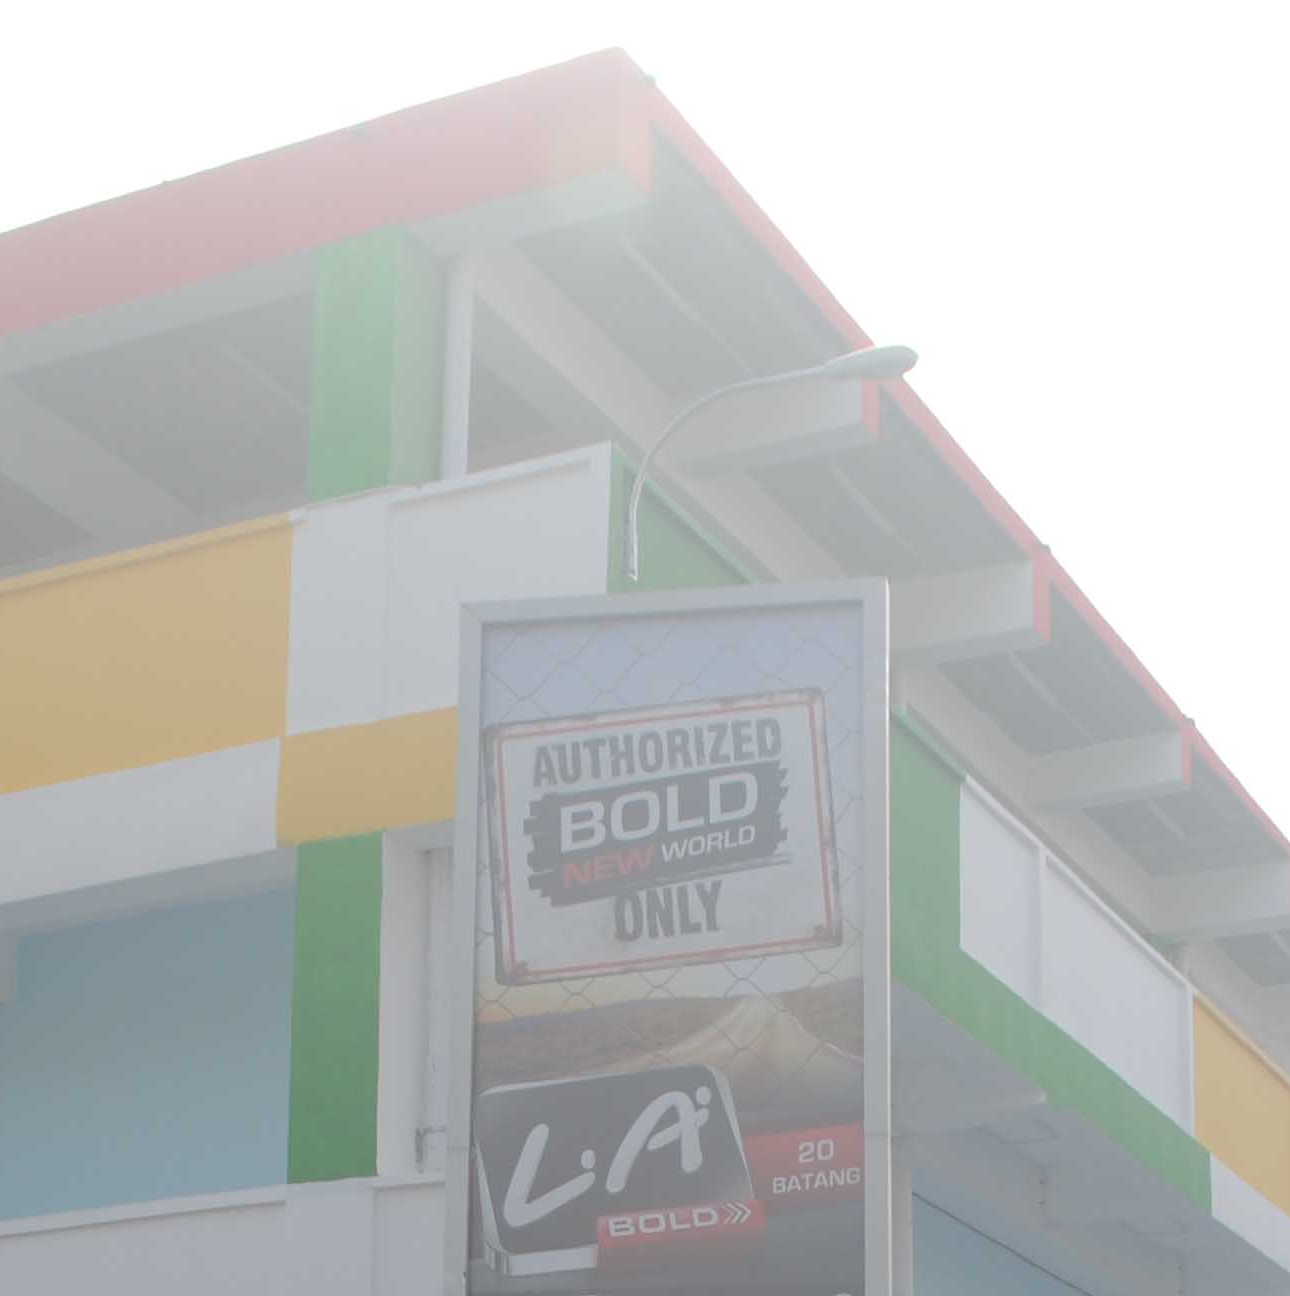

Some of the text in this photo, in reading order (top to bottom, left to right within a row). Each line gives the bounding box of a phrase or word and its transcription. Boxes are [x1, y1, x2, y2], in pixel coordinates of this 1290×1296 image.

[533, 717, 782, 788] AUTHORIZED
[560, 772, 759, 854] BOLD
[563, 825, 756, 888] NEW WORLD
[613, 879, 723, 943] ONLY
[772, 1167, 862, 1195] BATANG
[798, 1139, 836, 1164] 20
[608, 1205, 719, 1237] BOLD
